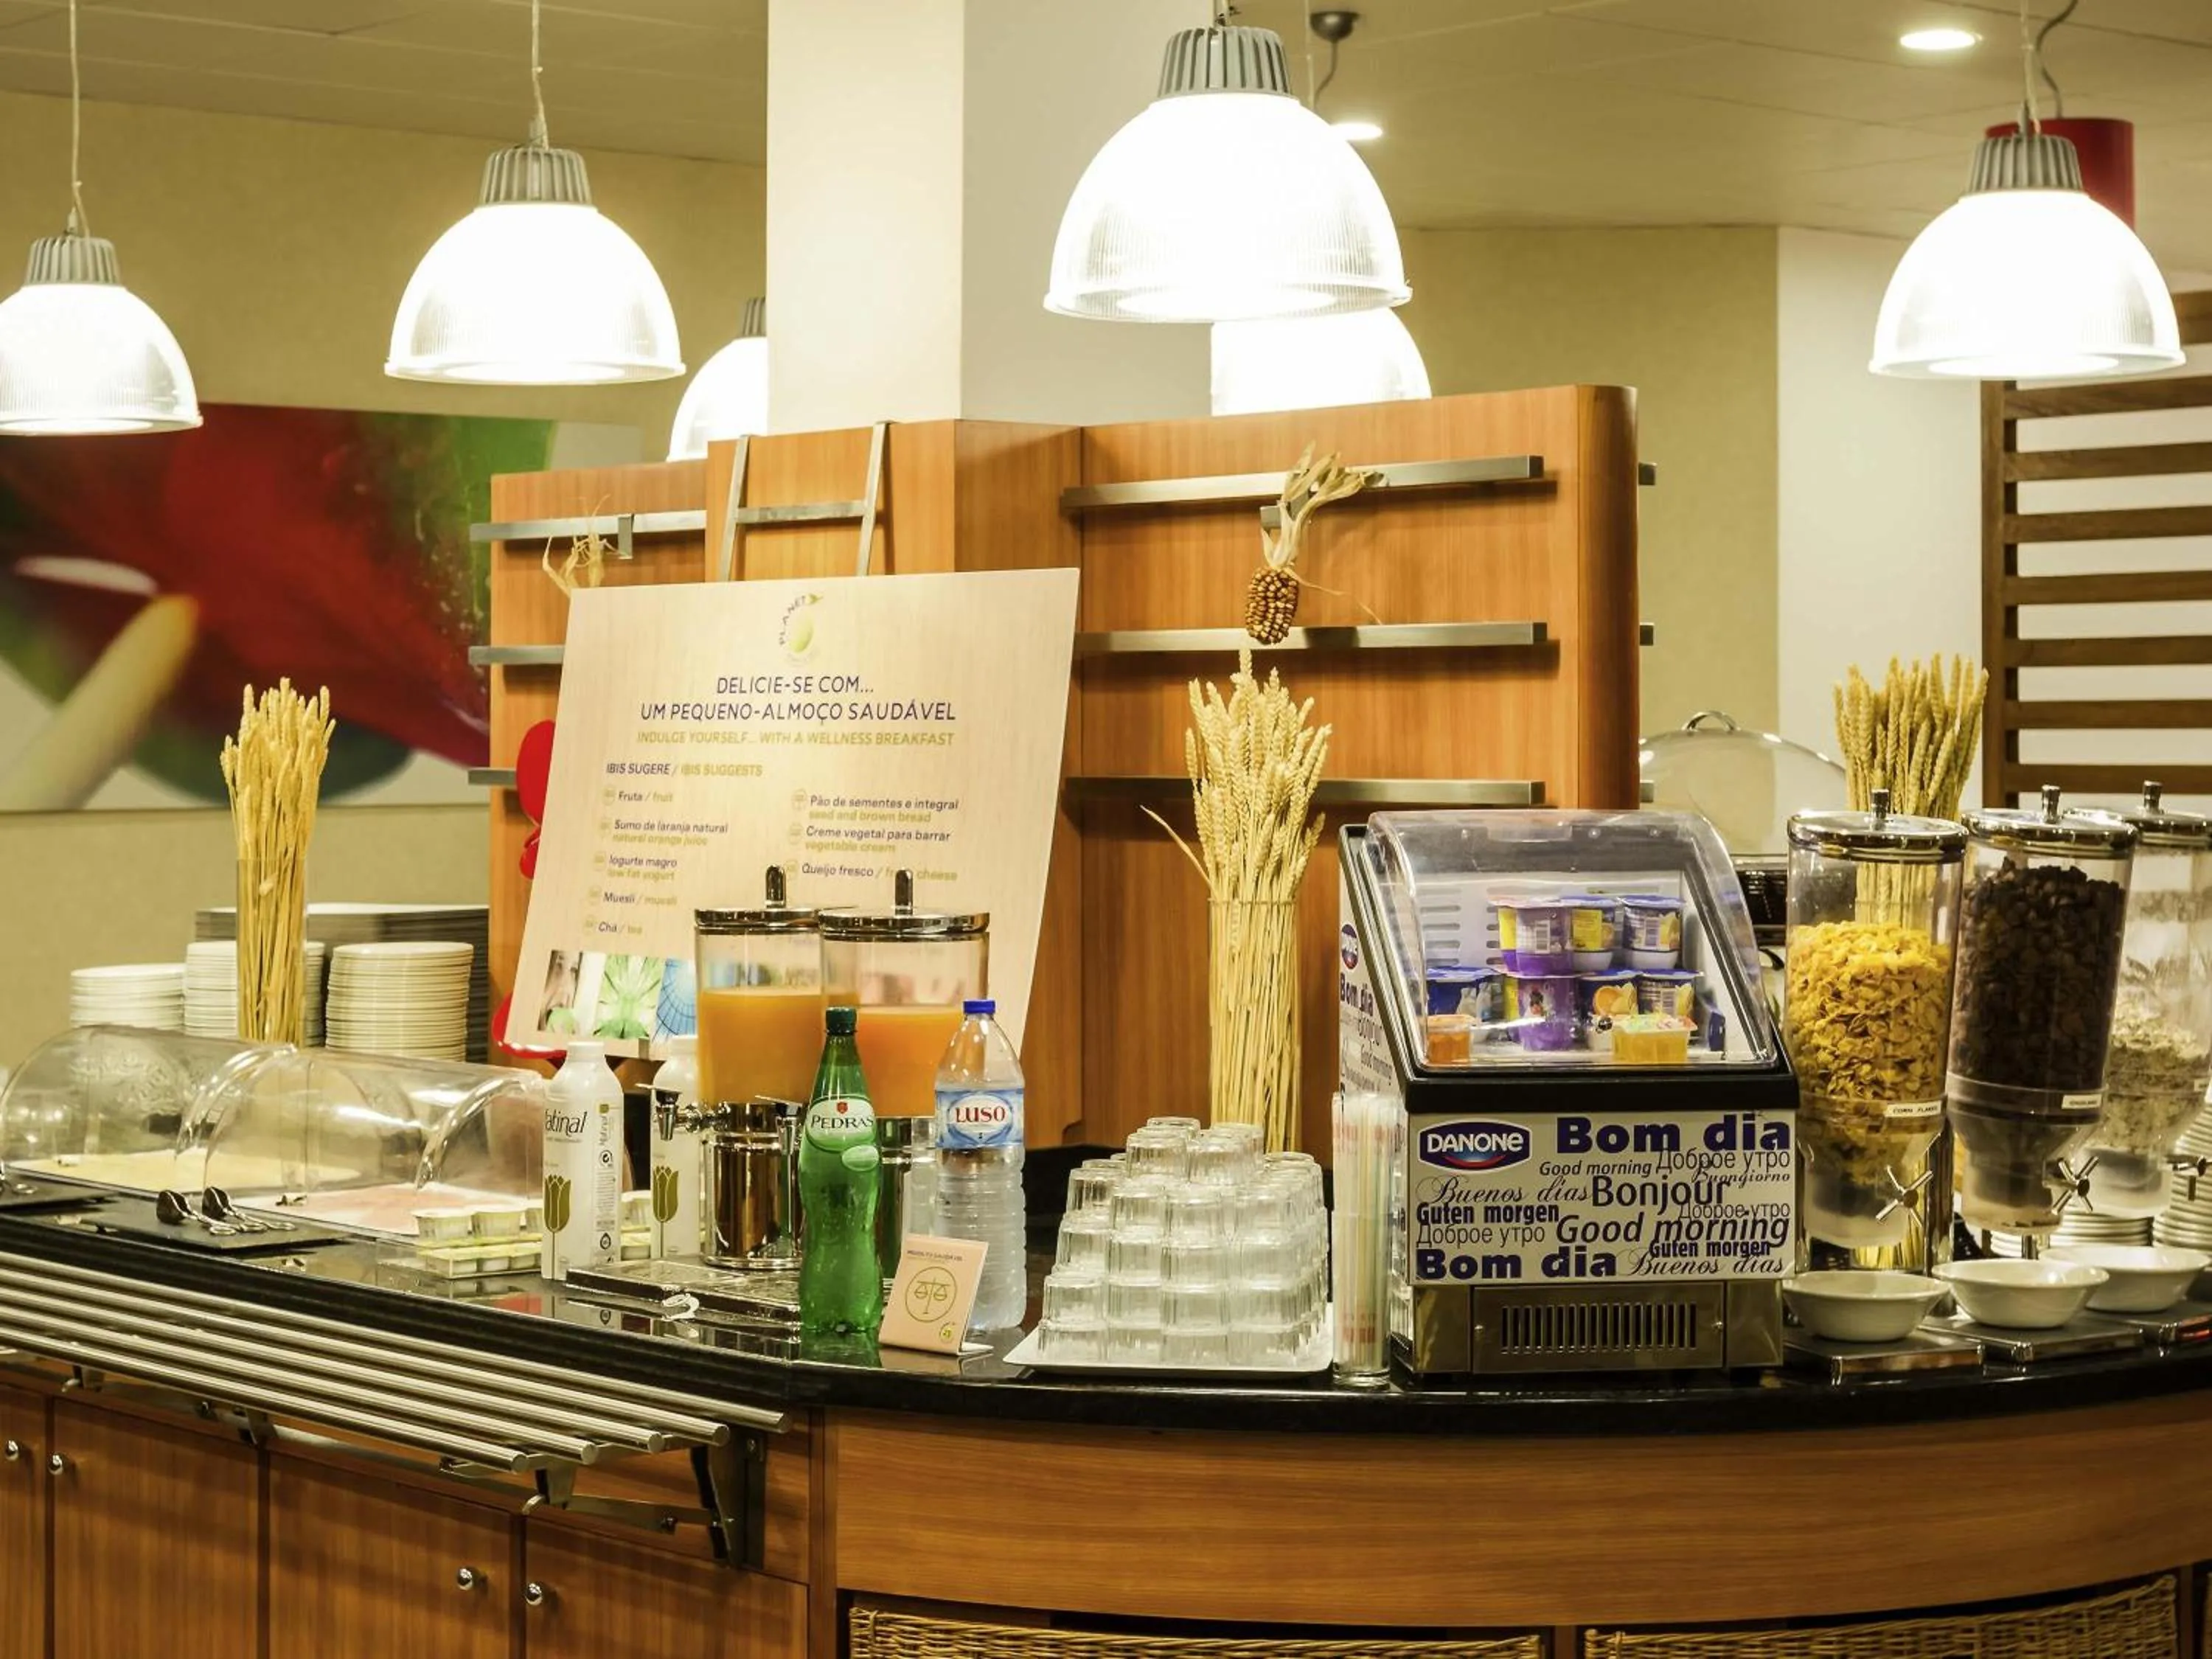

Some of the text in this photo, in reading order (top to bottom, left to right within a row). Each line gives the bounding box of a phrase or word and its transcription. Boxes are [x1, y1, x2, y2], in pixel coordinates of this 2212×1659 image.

[779, 594, 805, 646] PLANET
[717, 675, 874, 694] DELICIE-SE COM...
[641, 699, 956, 726] UM PEQUENO-ALMOÇO SAUDÁVEL
[637, 731, 686, 743] INDULGE
[760, 732, 791, 744] WITH
[793, 732, 803, 744] A
[807, 732, 872, 745] WELLNESS
[875, 732, 956, 745] BREAKFAST
[606, 763, 626, 774] IBIS
[627, 763, 670, 775] SUGERE
[681, 764, 700, 776] IBIS
[703, 764, 763, 776] SUGGESTS
[619, 791, 642, 802] Fruta
[653, 791, 674, 803] fruit
[832, 796, 846, 807] de
[849, 799, 902, 810] sementes
[905, 800, 912, 810] e
[914, 799, 959, 813] integral
[836, 810, 857, 821] and
[858, 811, 895, 822] brown
[897, 812, 931, 823] bread
[614, 819, 728, 834] Sumo de laranja natural
[806, 826, 950, 842] Creme vegetal para barrar
[613, 832, 709, 846] natural orange juice
[805, 841, 858, 853] vegetable
[609, 854, 678, 869] Iogurte magro
[642, 870, 675, 881] yogurt
[801, 863, 836, 878] Queijo
[838, 865, 874, 877] fresco
[917, 869, 958, 880] cheese
[603, 891, 636, 904] Muesli
[598, 921, 618, 933] Chá
[546, 1109, 588, 1136] atinal
[811, 1114, 874, 1130] PEDRAS
[956, 1106, 1006, 1123] LUSO
[1557, 1113, 1790, 1155] Bom dia
[1539, 1160, 1652, 1178] Good morning
[1655, 1147, 1790, 1174] Доброе утро
[1691, 1161, 1790, 1189] Buongiorno
[1416, 1175, 1524, 1205] Buenos
[1592, 1175, 1731, 1216] Bonjour
[1416, 1201, 1559, 1225] Guten morgen
[1677, 1196, 1790, 1223] Доброе утро
[1416, 1223, 1545, 1248] Доброе утро
[1556, 1210, 1790, 1248] Good morning
[1649, 1238, 1770, 1259] Guten morgen
[1416, 1245, 1617, 1280] Bom dia
[1619, 1248, 1720, 1276] Buenos
